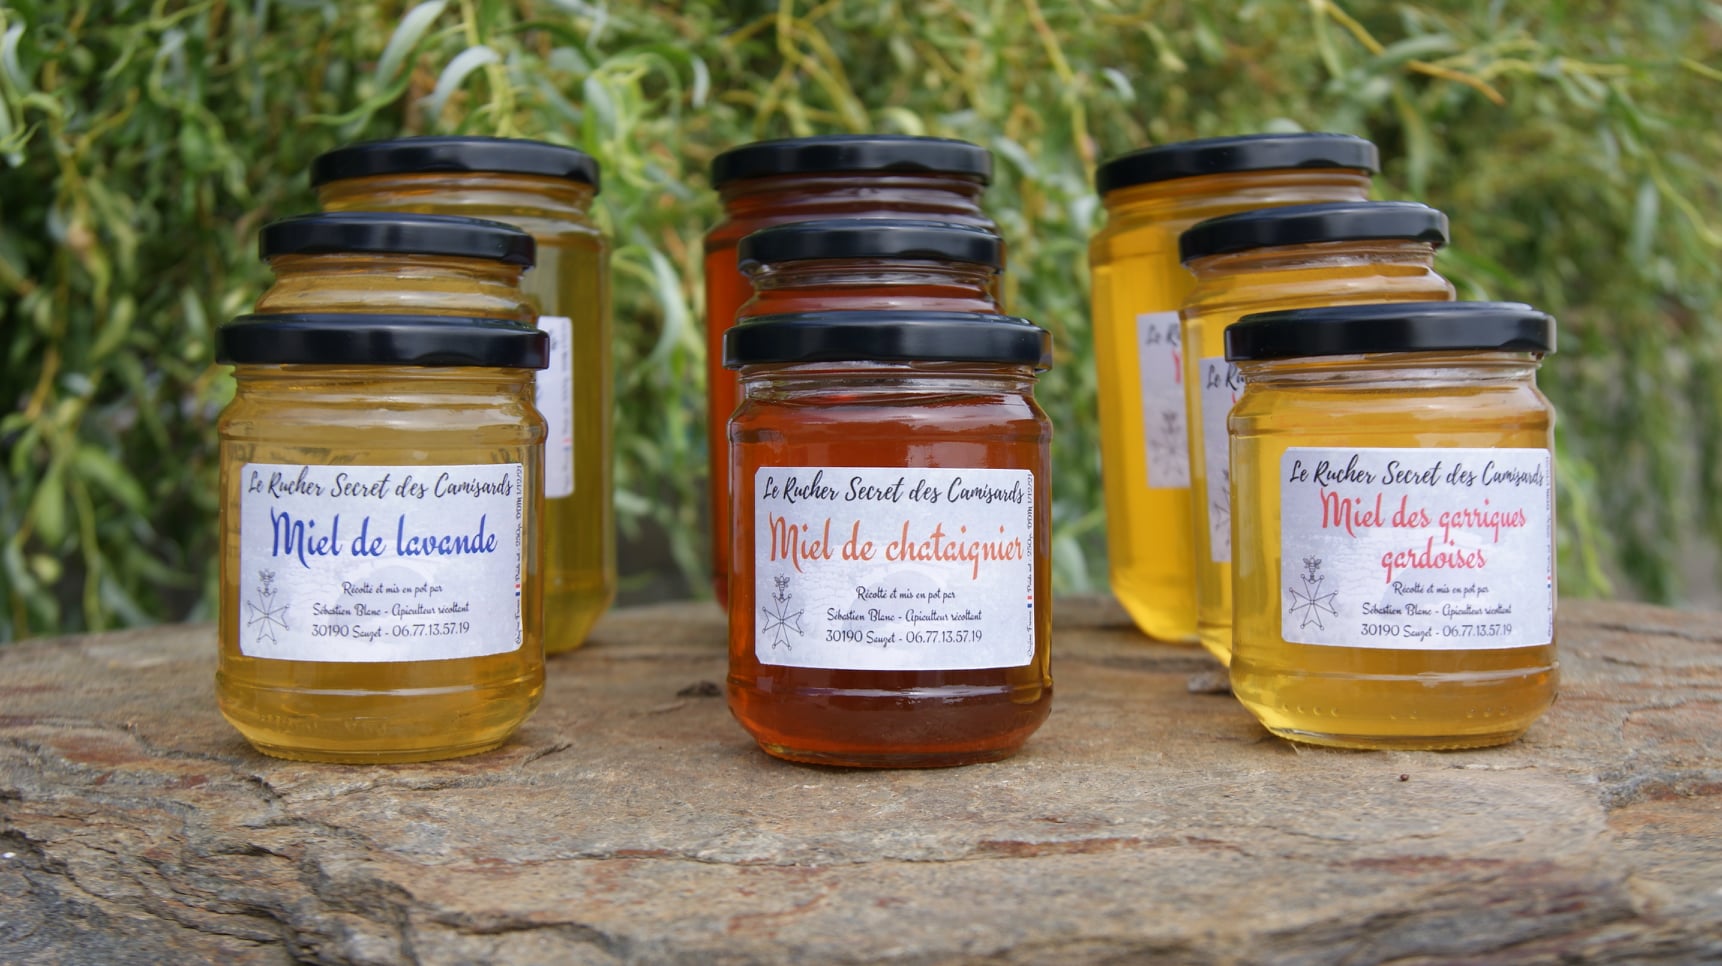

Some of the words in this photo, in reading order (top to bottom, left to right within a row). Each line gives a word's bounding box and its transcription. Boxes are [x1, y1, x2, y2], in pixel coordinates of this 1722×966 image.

[1206, 364, 1221, 389] Le
[1290, 460, 1309, 483] Le
[1313, 454, 1376, 487] Rucher
[1382, 460, 1442, 486] Secret
[1446, 463, 1477, 486] des
[1482, 460, 1544, 487] Camisards
[248, 470, 263, 493] Le
[268, 465, 325, 499] Rucher
[330, 472, 390, 499] Secret
[395, 475, 429, 499] des
[434, 472, 513, 497] Camisards
[763, 476, 779, 500] Le
[783, 470, 839, 504] Rucher
[845, 476, 904, 503] Secret
[909, 479, 942, 503] des
[947, 477, 1024, 504] Camisards
[1320, 487, 1386, 539] Miel
[1392, 494, 1431, 528] des
[1439, 498, 1526, 544] garrigues
[271, 506, 343, 569] Miel
[351, 516, 386, 556] de
[397, 513, 497, 556] lavande
[769, 512, 834, 573] Miel
[842, 520, 877, 561] de
[886, 520, 1023, 580] chataignier
[1381, 536, 1487, 584] gardoises
[342, 581, 373, 596] Récolté
[376, 584, 383, 594] et
[386, 584, 400, 594] mis
[415, 582, 427, 597] pot
[430, 585, 443, 597] par
[856, 586, 887, 601] Récolté
[890, 589, 897, 599] et
[900, 589, 914, 599] mis
[928, 588, 941, 604] pot
[943, 592, 956, 603] par
[1392, 581, 1424, 596] Récolté
[1426, 585, 1434, 593] et
[1436, 584, 1450, 593] mis
[1464, 583, 1476, 598] pot
[1477, 587, 1489, 597] par
[313, 602, 351, 616] Sébastien
[354, 603, 381, 616] Blanc
[392, 603, 435, 619] Apiculteur
[438, 602, 469, 614] récoltant
[826, 607, 865, 621] Sébastien
[868, 608, 895, 621] Blanc
[905, 609, 949, 626] Apiculteur
[951, 609, 982, 621] récoltant
[1362, 602, 1402, 615] Sébastien
[1405, 604, 1432, 615] Blanc
[1442, 604, 1483, 620] Apiculteur
[312, 624, 349, 637] 30190
[352, 625, 382, 642] Sauzet
[392, 621, 470, 637] 06.77.13.57.19
[826, 629, 863, 642] 30190
[866, 630, 895, 648] Sauzet
[906, 630, 983, 643] 06.77.13.57.19
[1361, 623, 1400, 636] 30190
[1403, 625, 1432, 642] Sauzet
[1443, 624, 1512, 637] 06.77.13.57.19
